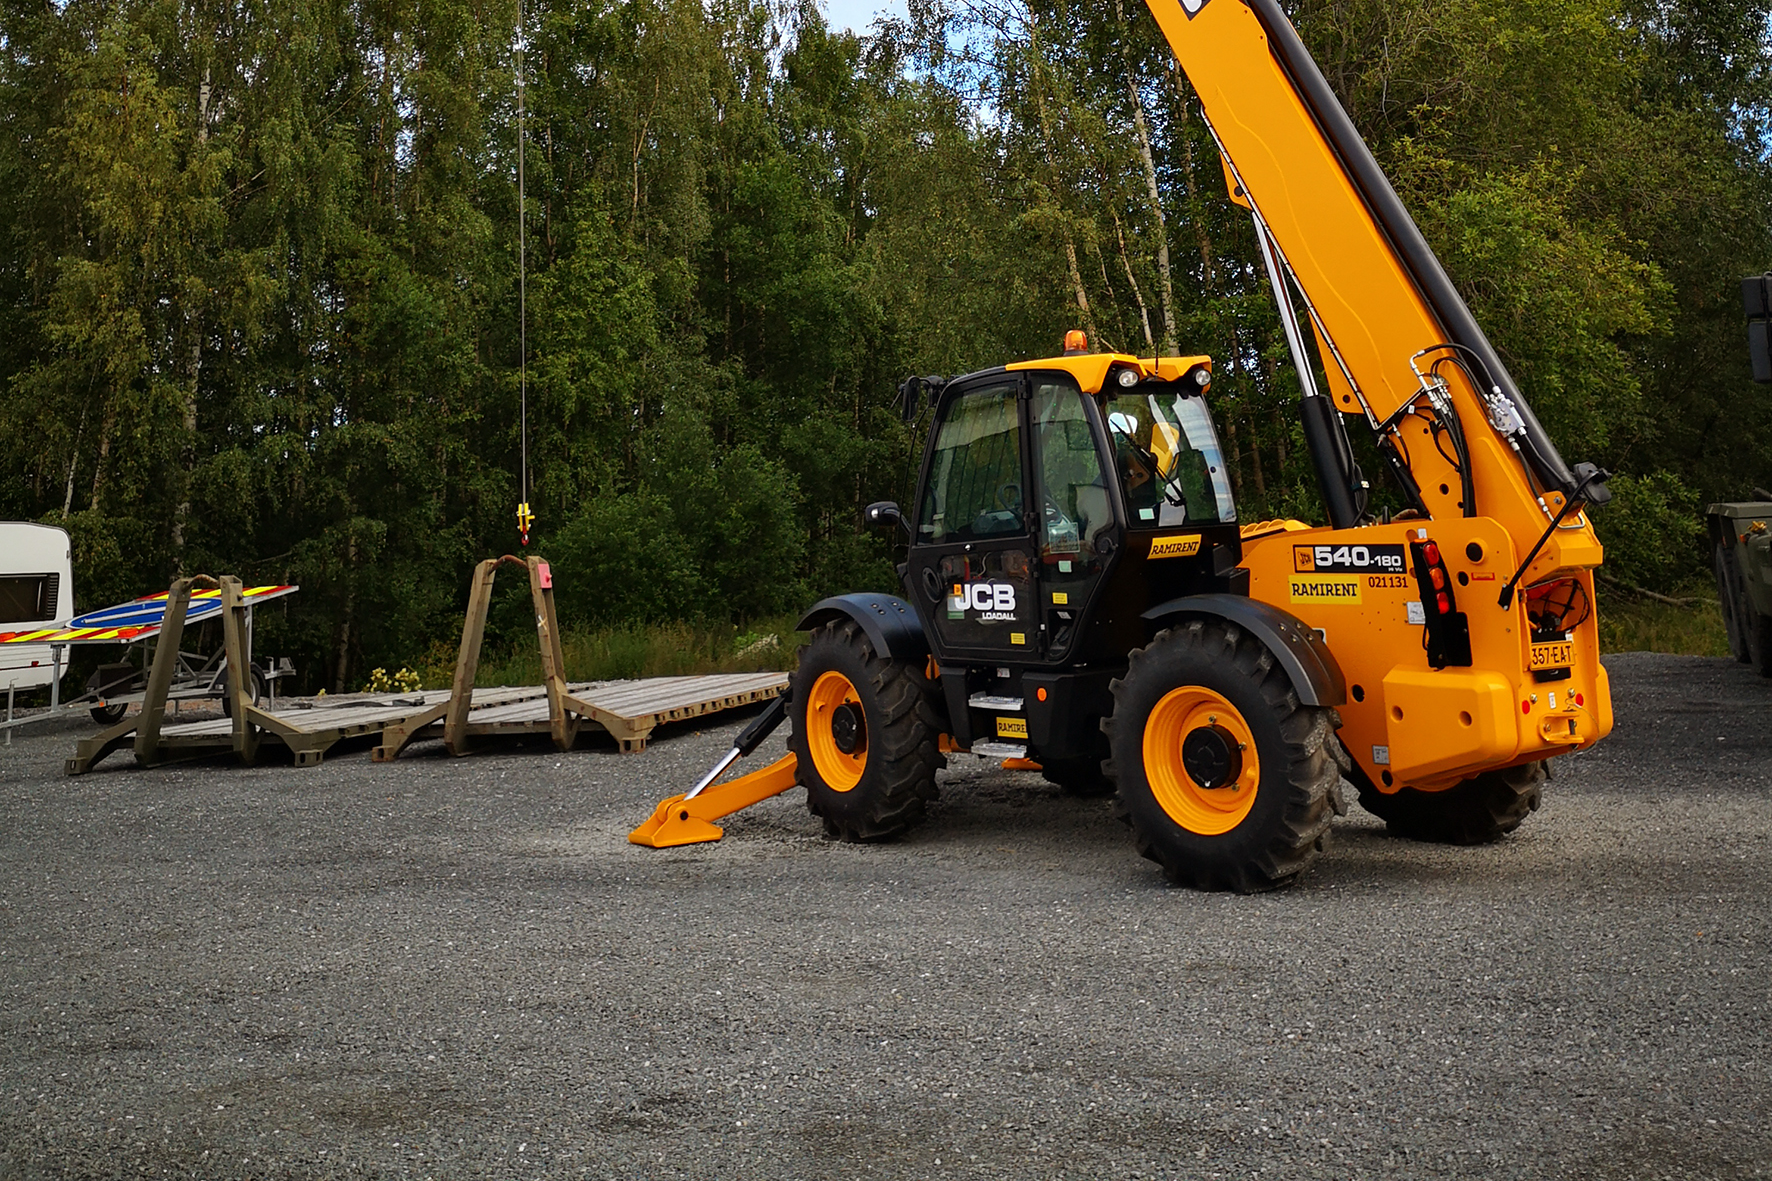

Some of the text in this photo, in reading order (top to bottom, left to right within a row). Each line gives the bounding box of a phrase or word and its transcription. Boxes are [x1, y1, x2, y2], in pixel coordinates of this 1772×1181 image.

[1151, 541, 1199, 555] RAMIRENT
[1315, 546, 1402, 567] 540-180
[1368, 576, 1409, 588] 021131
[1291, 583, 1358, 597] RAMIRENT
[955, 584, 1016, 611] JCB
[982, 612, 1016, 621] LOADALL
[1531, 645, 1571, 665] 357-EAT
